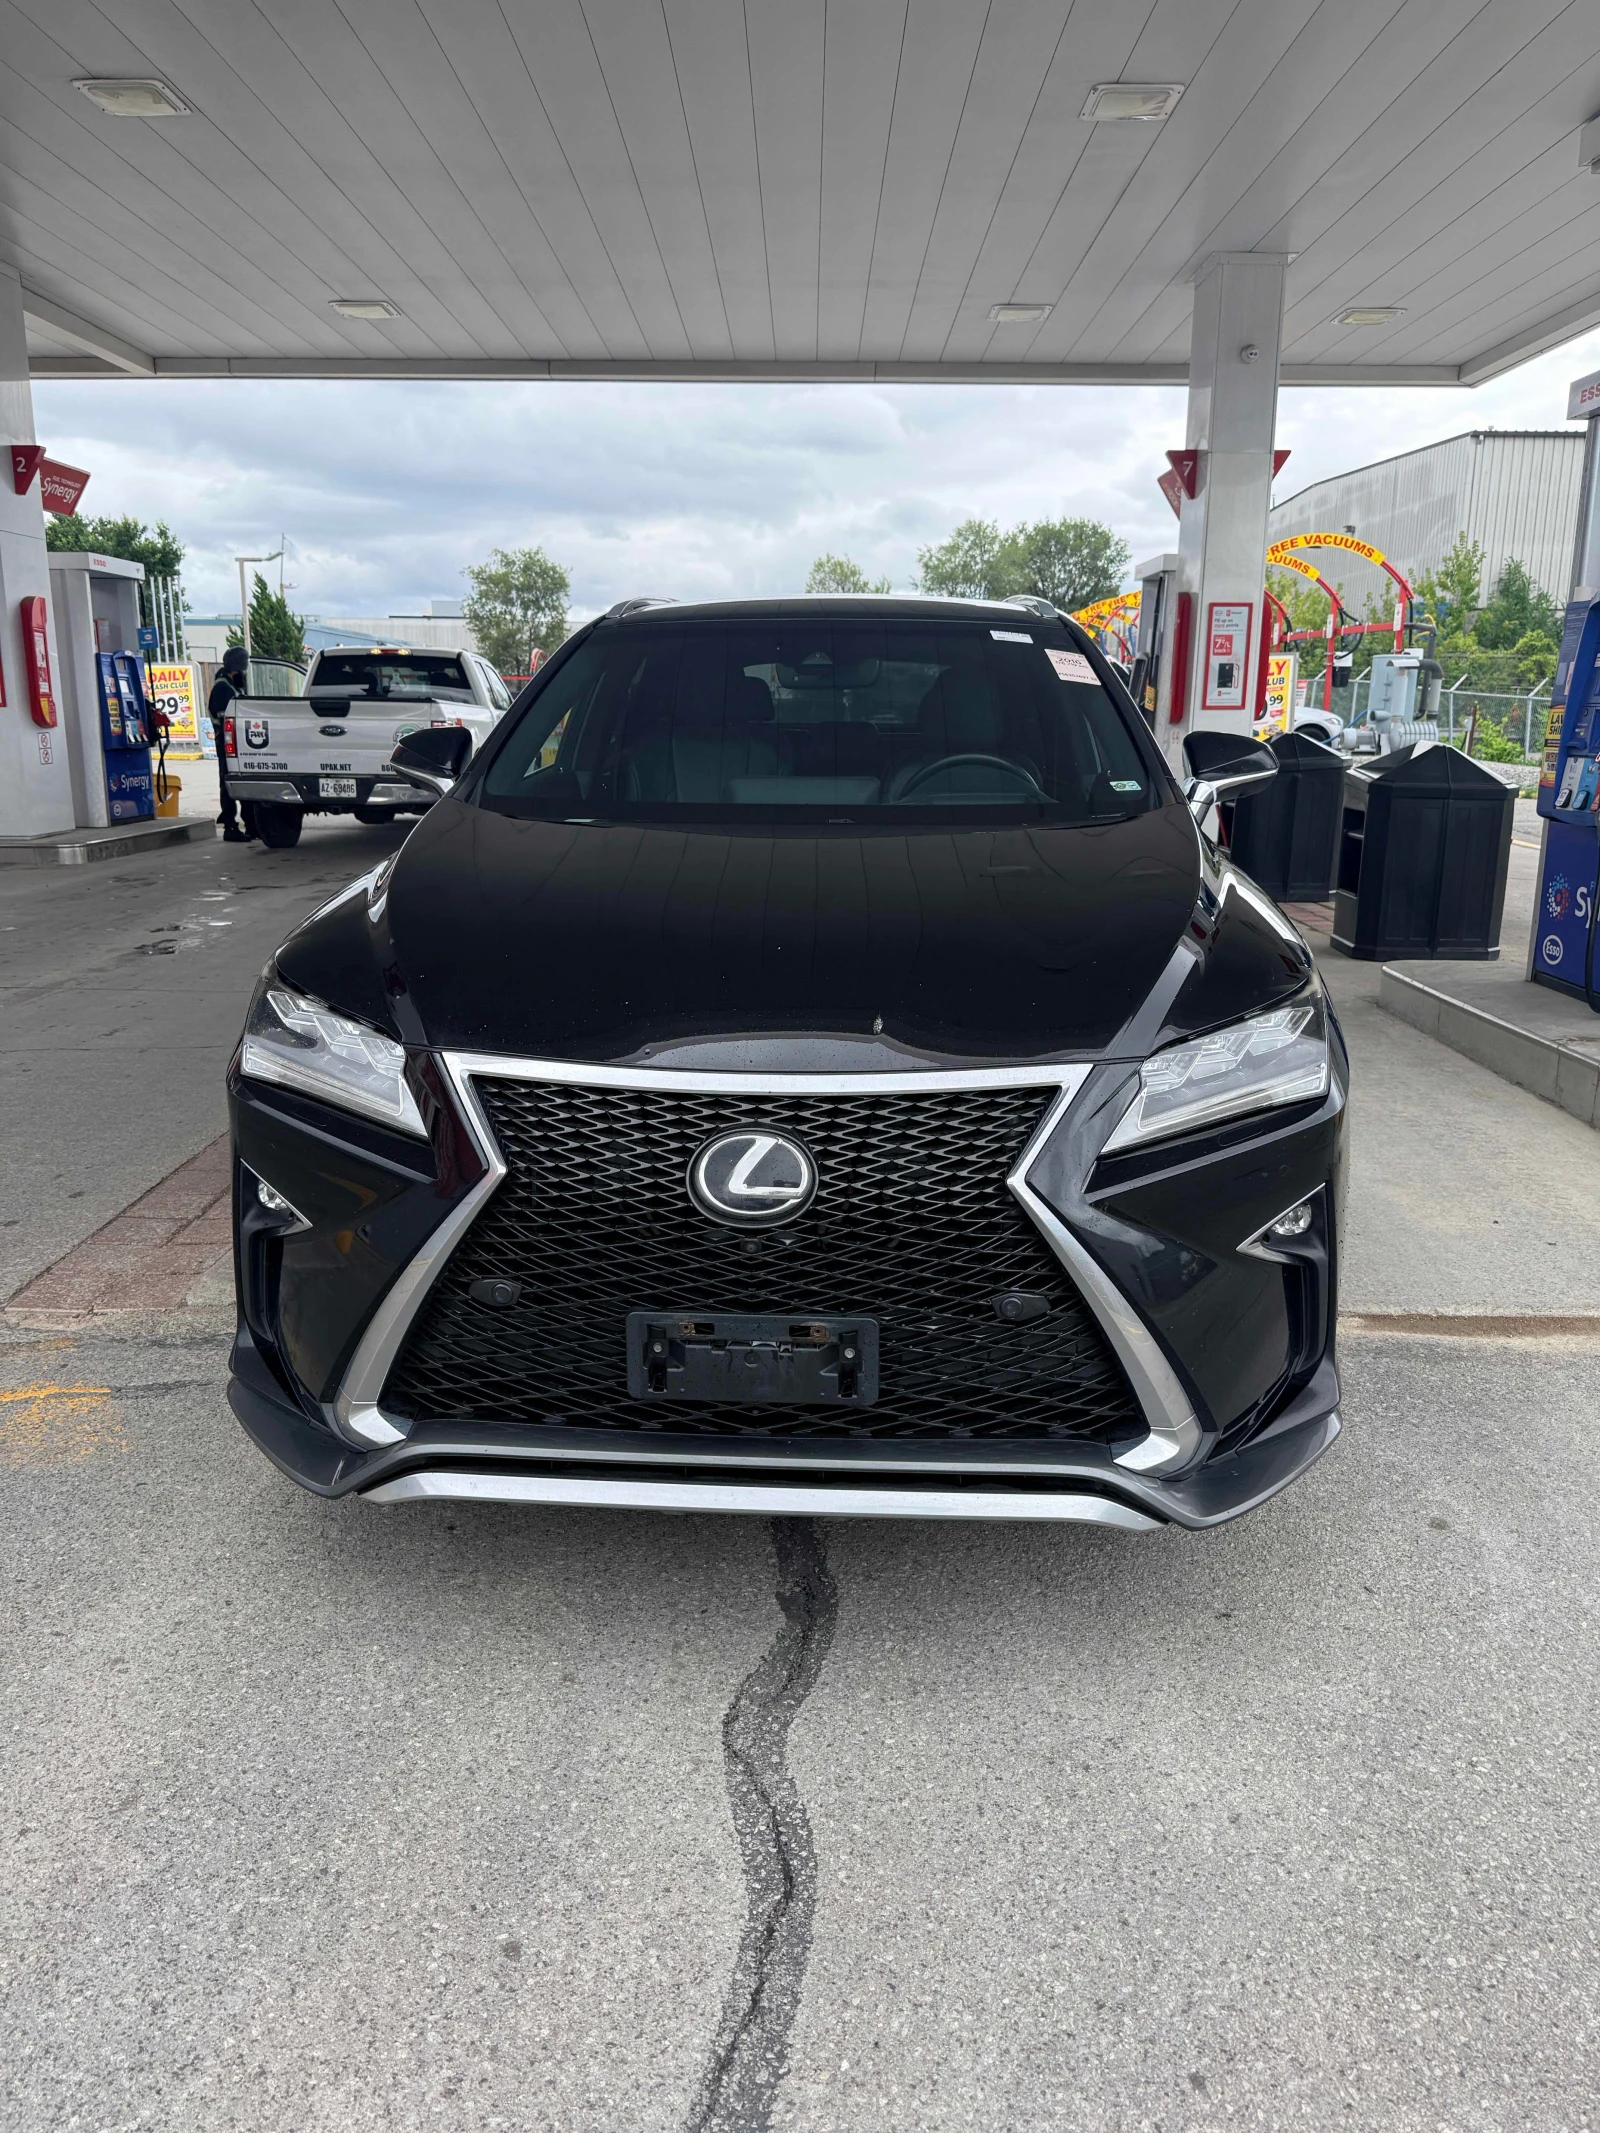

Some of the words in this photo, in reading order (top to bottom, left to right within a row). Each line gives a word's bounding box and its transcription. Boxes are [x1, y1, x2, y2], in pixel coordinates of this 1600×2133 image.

[16, 457, 27, 473] 2
[1183, 461, 1193, 476] 7
[41, 477, 78, 504] Synergy
[1266, 537, 1299, 556] REE
[1303, 534, 1375, 558] VACUUMS
[93, 558, 106, 567] ESSO
[1267, 554, 1311, 575] UUMS
[148, 669, 188, 683] DAILY
[178, 694, 190, 703] 99
[1269, 695, 1284, 705] 99
[243, 762, 288, 770] 416-675-3700
[320, 763, 352, 771] UPAK.NET
[120, 774, 150, 792] Synergy
